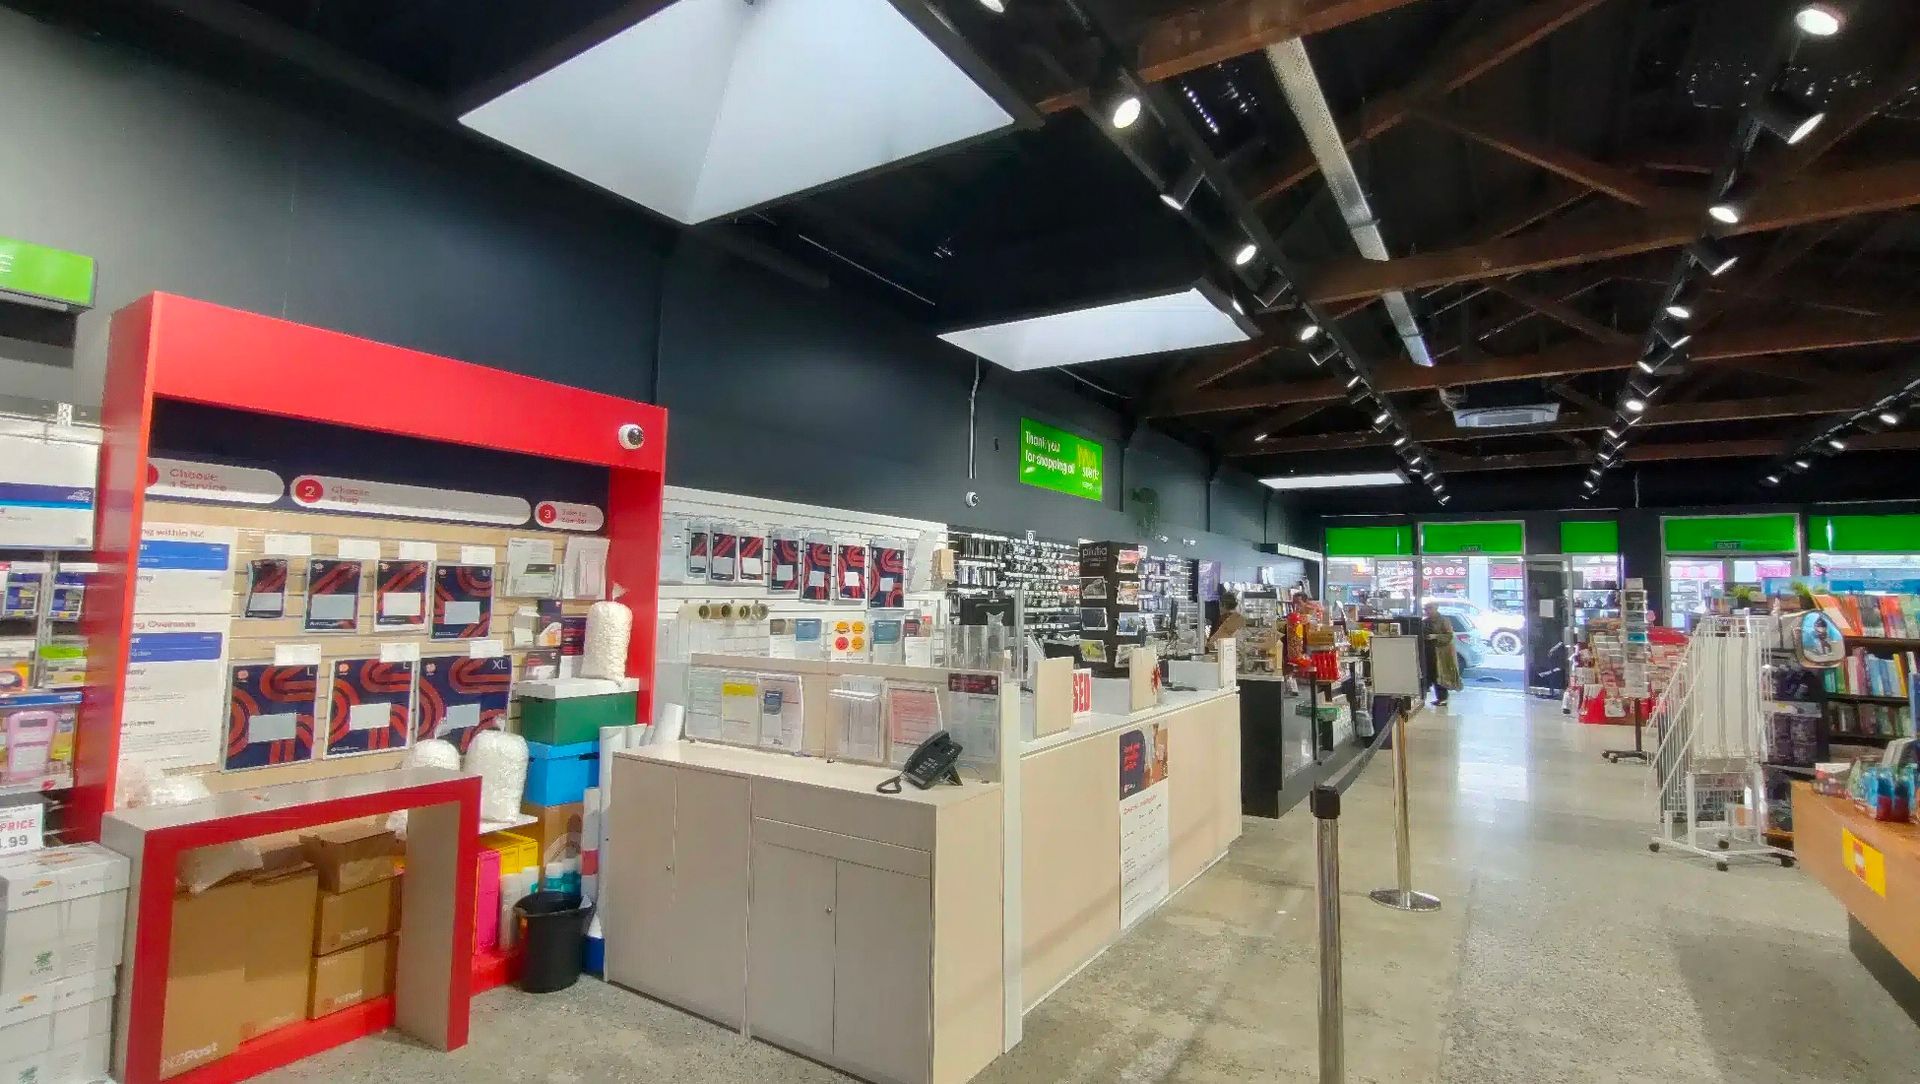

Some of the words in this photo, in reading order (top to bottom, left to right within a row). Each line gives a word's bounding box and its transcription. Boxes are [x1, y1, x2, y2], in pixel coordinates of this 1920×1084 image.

[1026, 431, 1046, 450] Thank
[1047, 441, 1060, 452] you
[1026, 450, 1035, 462] for
[1036, 454, 1067, 475] shopping
[170, 468, 219, 481] Choose
[180, 480, 227, 492] Service
[304, 486, 315, 497] 2
[544, 509, 551, 519] 3
[156, 529, 188, 537] within
[190, 530, 204, 538] NZ
[403, 661, 409, 670] L
[492, 660, 508, 670] XL
[306, 667, 313, 676] L
